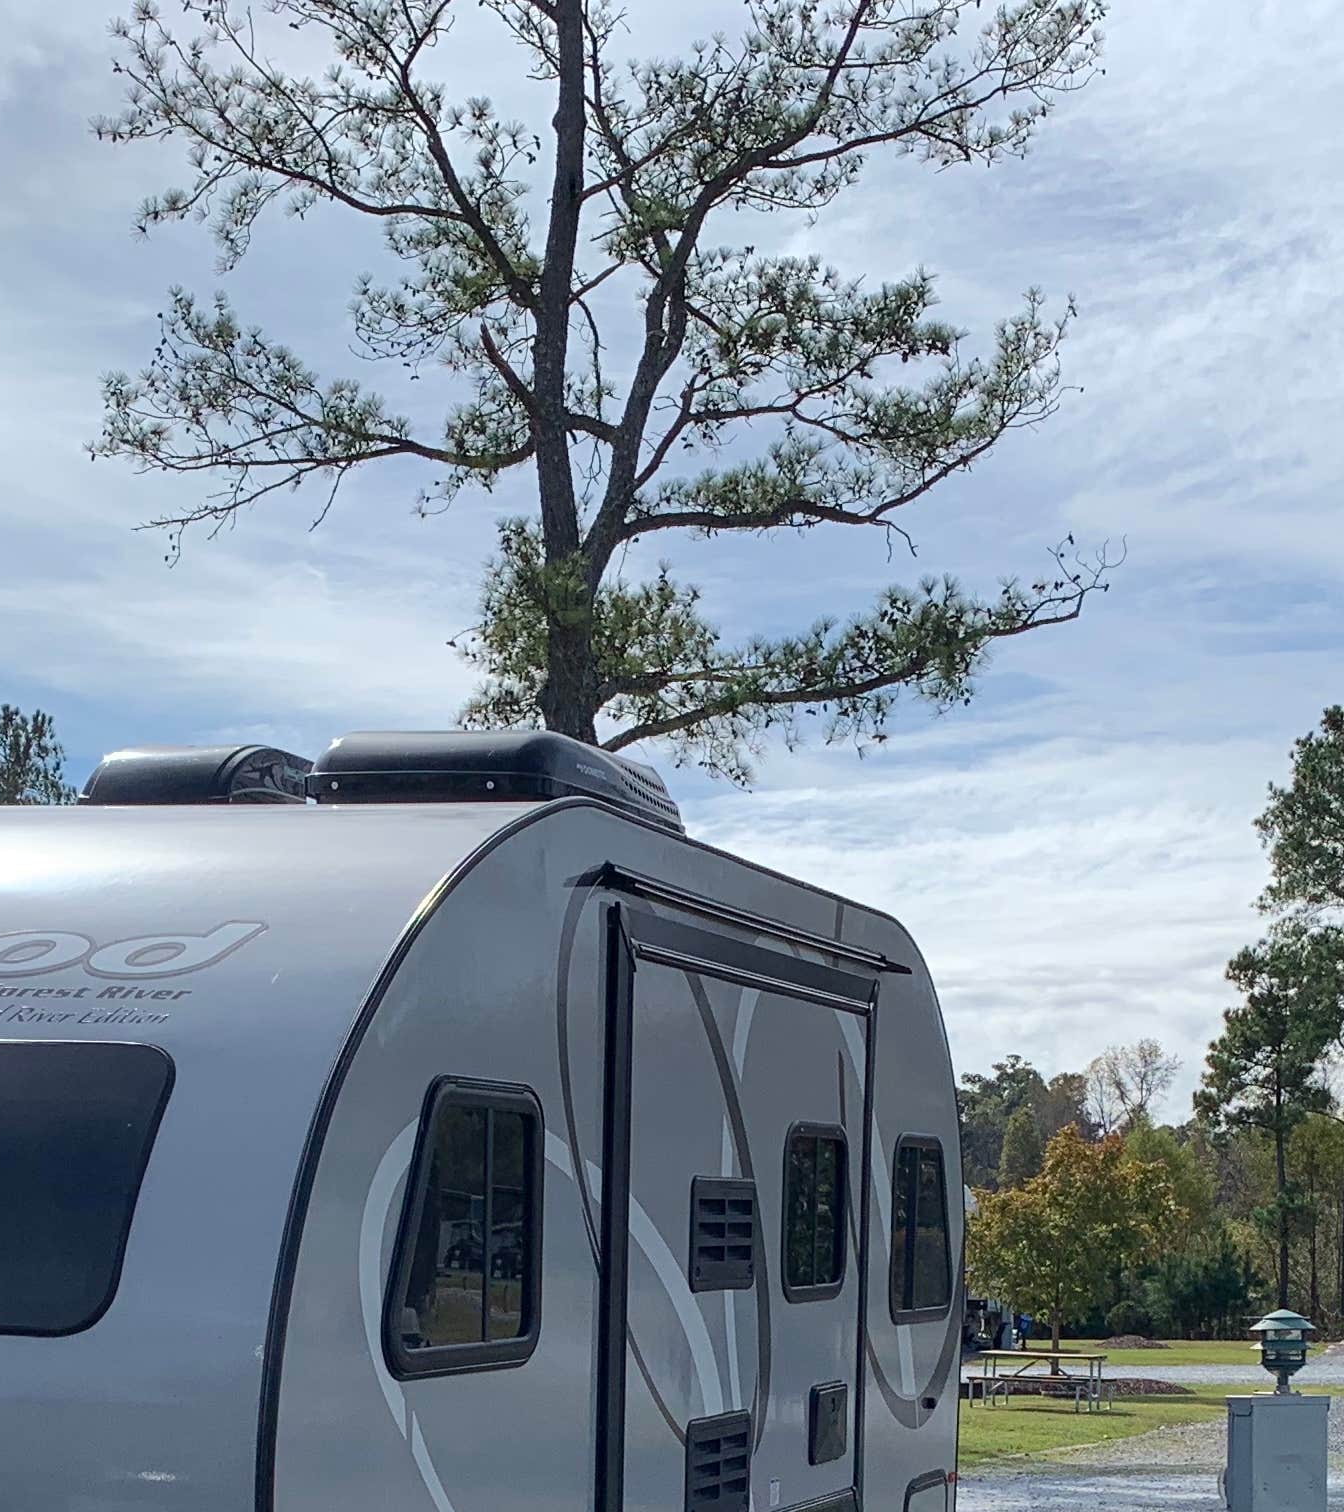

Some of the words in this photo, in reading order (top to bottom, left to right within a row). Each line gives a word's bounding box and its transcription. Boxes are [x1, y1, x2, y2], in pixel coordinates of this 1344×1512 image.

[96, 985, 193, 1000] River
[7, 1006, 76, 1023] River
[76, 1006, 171, 1024] Edition
